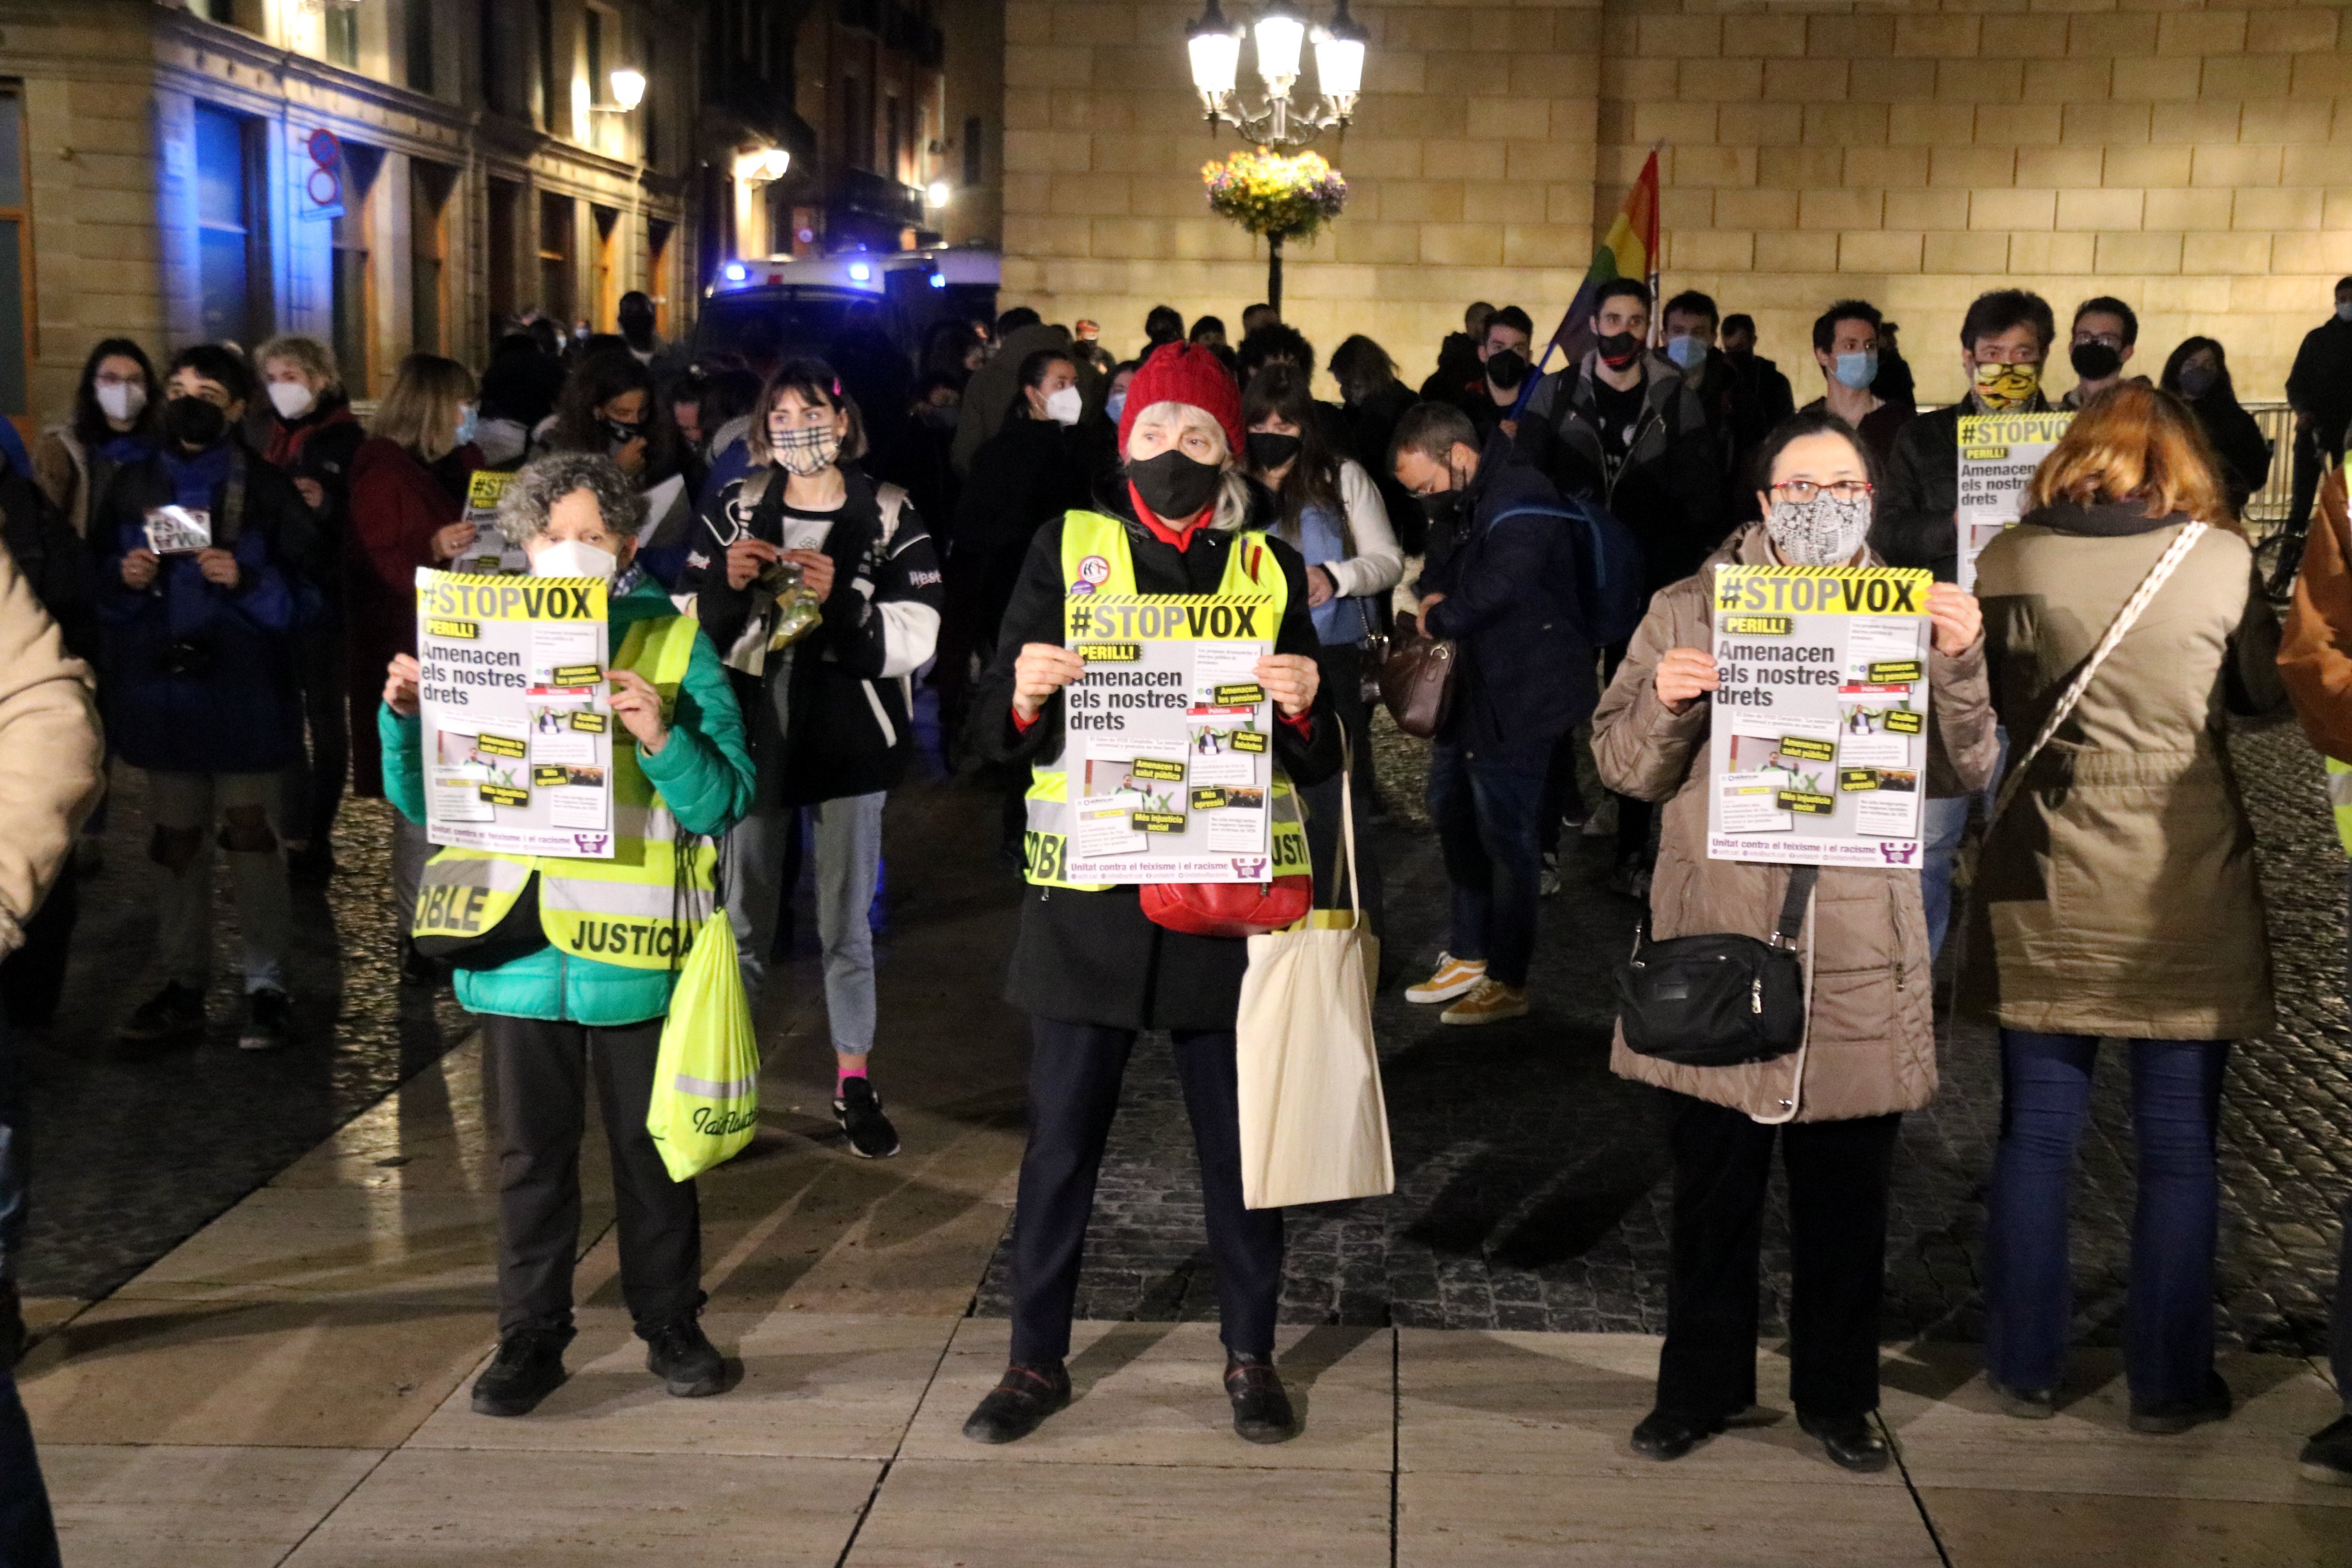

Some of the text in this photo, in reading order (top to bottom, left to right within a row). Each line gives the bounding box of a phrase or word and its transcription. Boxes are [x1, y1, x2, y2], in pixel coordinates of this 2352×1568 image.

[1962, 421, 2068, 444] #STOPVO
[1967, 449, 2004, 459] PERILL!
[1962, 478, 2029, 491] els nostr
[1962, 493, 1997, 505] drets
[422, 582, 592, 619] #STOPVOX
[1721, 577, 1915, 613] #STOPVOX
[426, 621, 474, 638] PERILL!
[1070, 606, 1257, 638] #STOPVOX
[1727, 618, 1785, 633] PERILL!
[422, 640, 520, 666] Amenacen
[1079, 645, 1135, 661] PERILL!
[1718, 640, 1835, 663] Amenacen
[422, 662, 526, 688] els nostres
[1718, 663, 1840, 685] els nostres
[424, 683, 469, 705] drets
[1220, 686, 1259, 695] Amenacen
[1717, 686, 1773, 706] drets
[1071, 689, 1188, 709] els nostres
[1230, 694, 1262, 704] pensions
[1071, 711, 1125, 731] drets
[1136, 760, 1174, 770] Amenacen
[1135, 769, 1153, 777] salut
[1154, 771, 1180, 781] pública
[1194, 798, 1224, 809] opressió
[1134, 813, 1183, 824] Més injustícia
[1147, 823, 1169, 831] social
[1712, 839, 1738, 848] Unitat
[1741, 841, 1770, 849] contra
[1783, 842, 1821, 852] feixisme
[1071, 863, 1097, 871] Unitat
[1099, 863, 1127, 871] contra
[1130, 863, 1137, 871] el
[1140, 862, 1176, 871] feixisme
[1184, 862, 1192, 870] el
[1195, 862, 1228, 870] racisme
